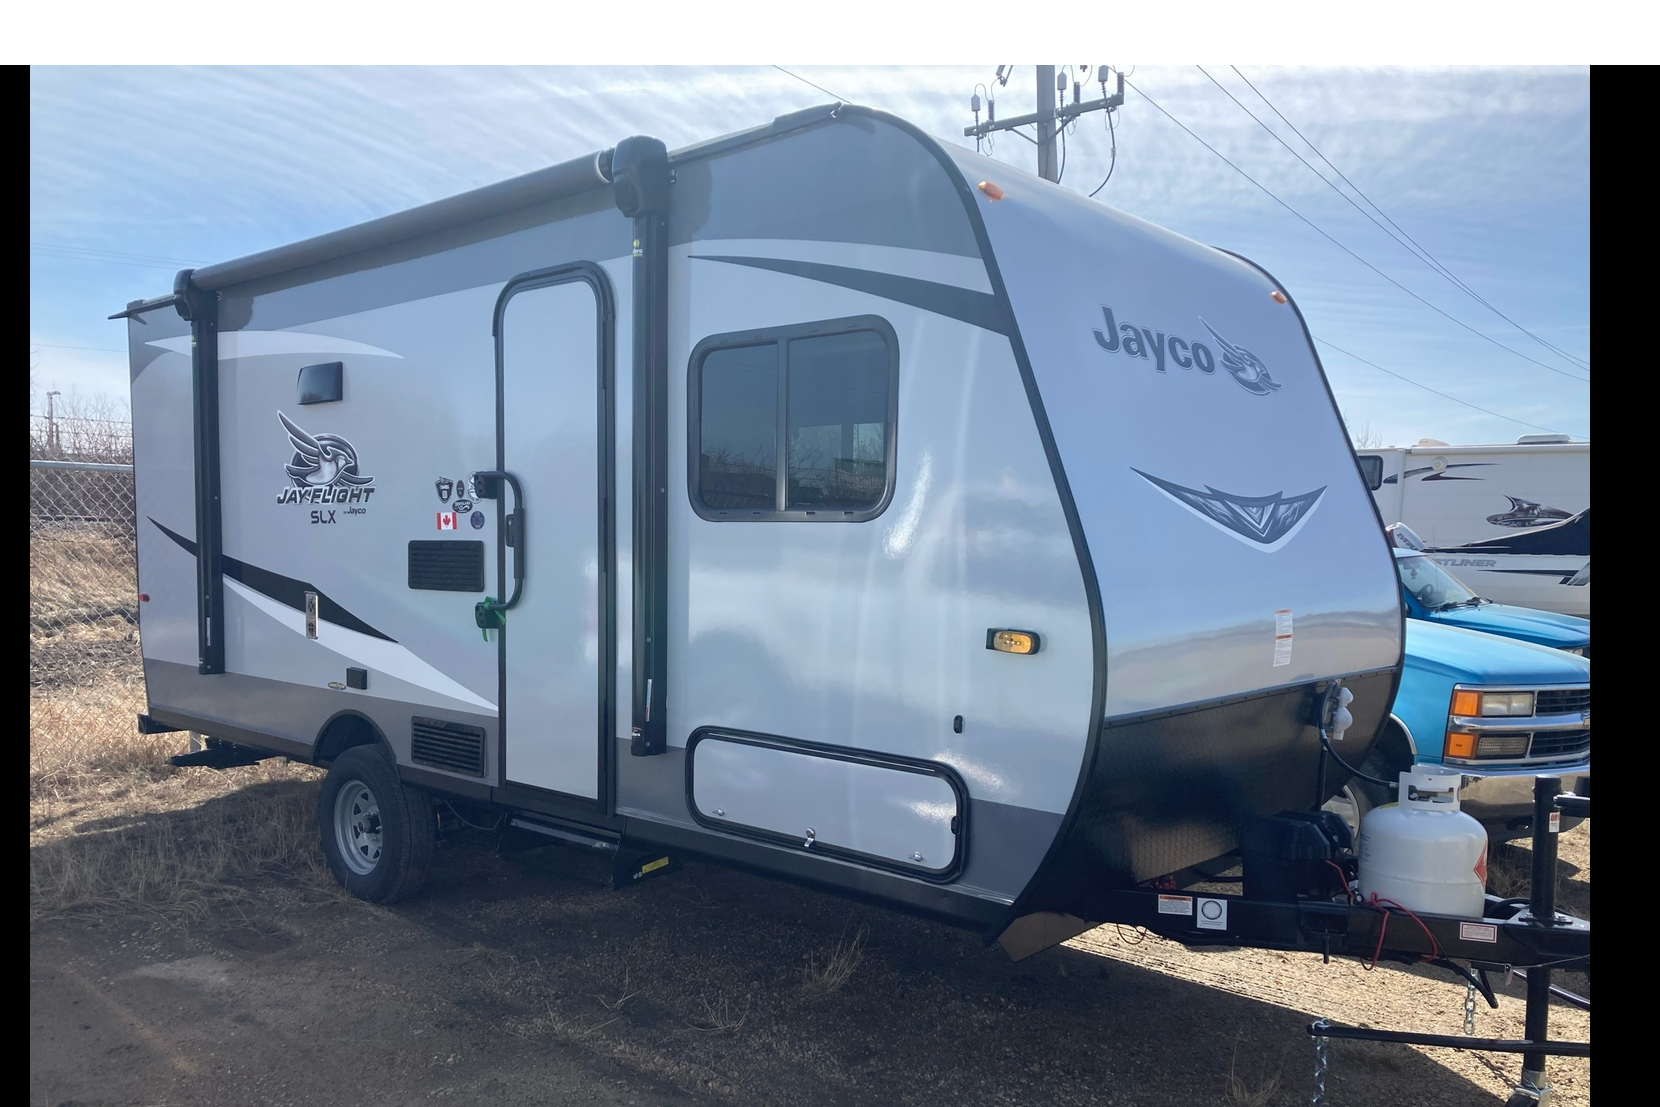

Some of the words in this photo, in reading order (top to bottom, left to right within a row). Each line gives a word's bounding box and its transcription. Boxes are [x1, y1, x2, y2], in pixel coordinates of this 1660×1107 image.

[1092, 304, 1215, 375] Jayco
[276, 487, 310, 505] JAY
[310, 487, 376, 504] FLIGHT
[311, 510, 336, 524] SLX
[347, 506, 367, 516] Jayco
[1434, 558, 1497, 567] STLINER
